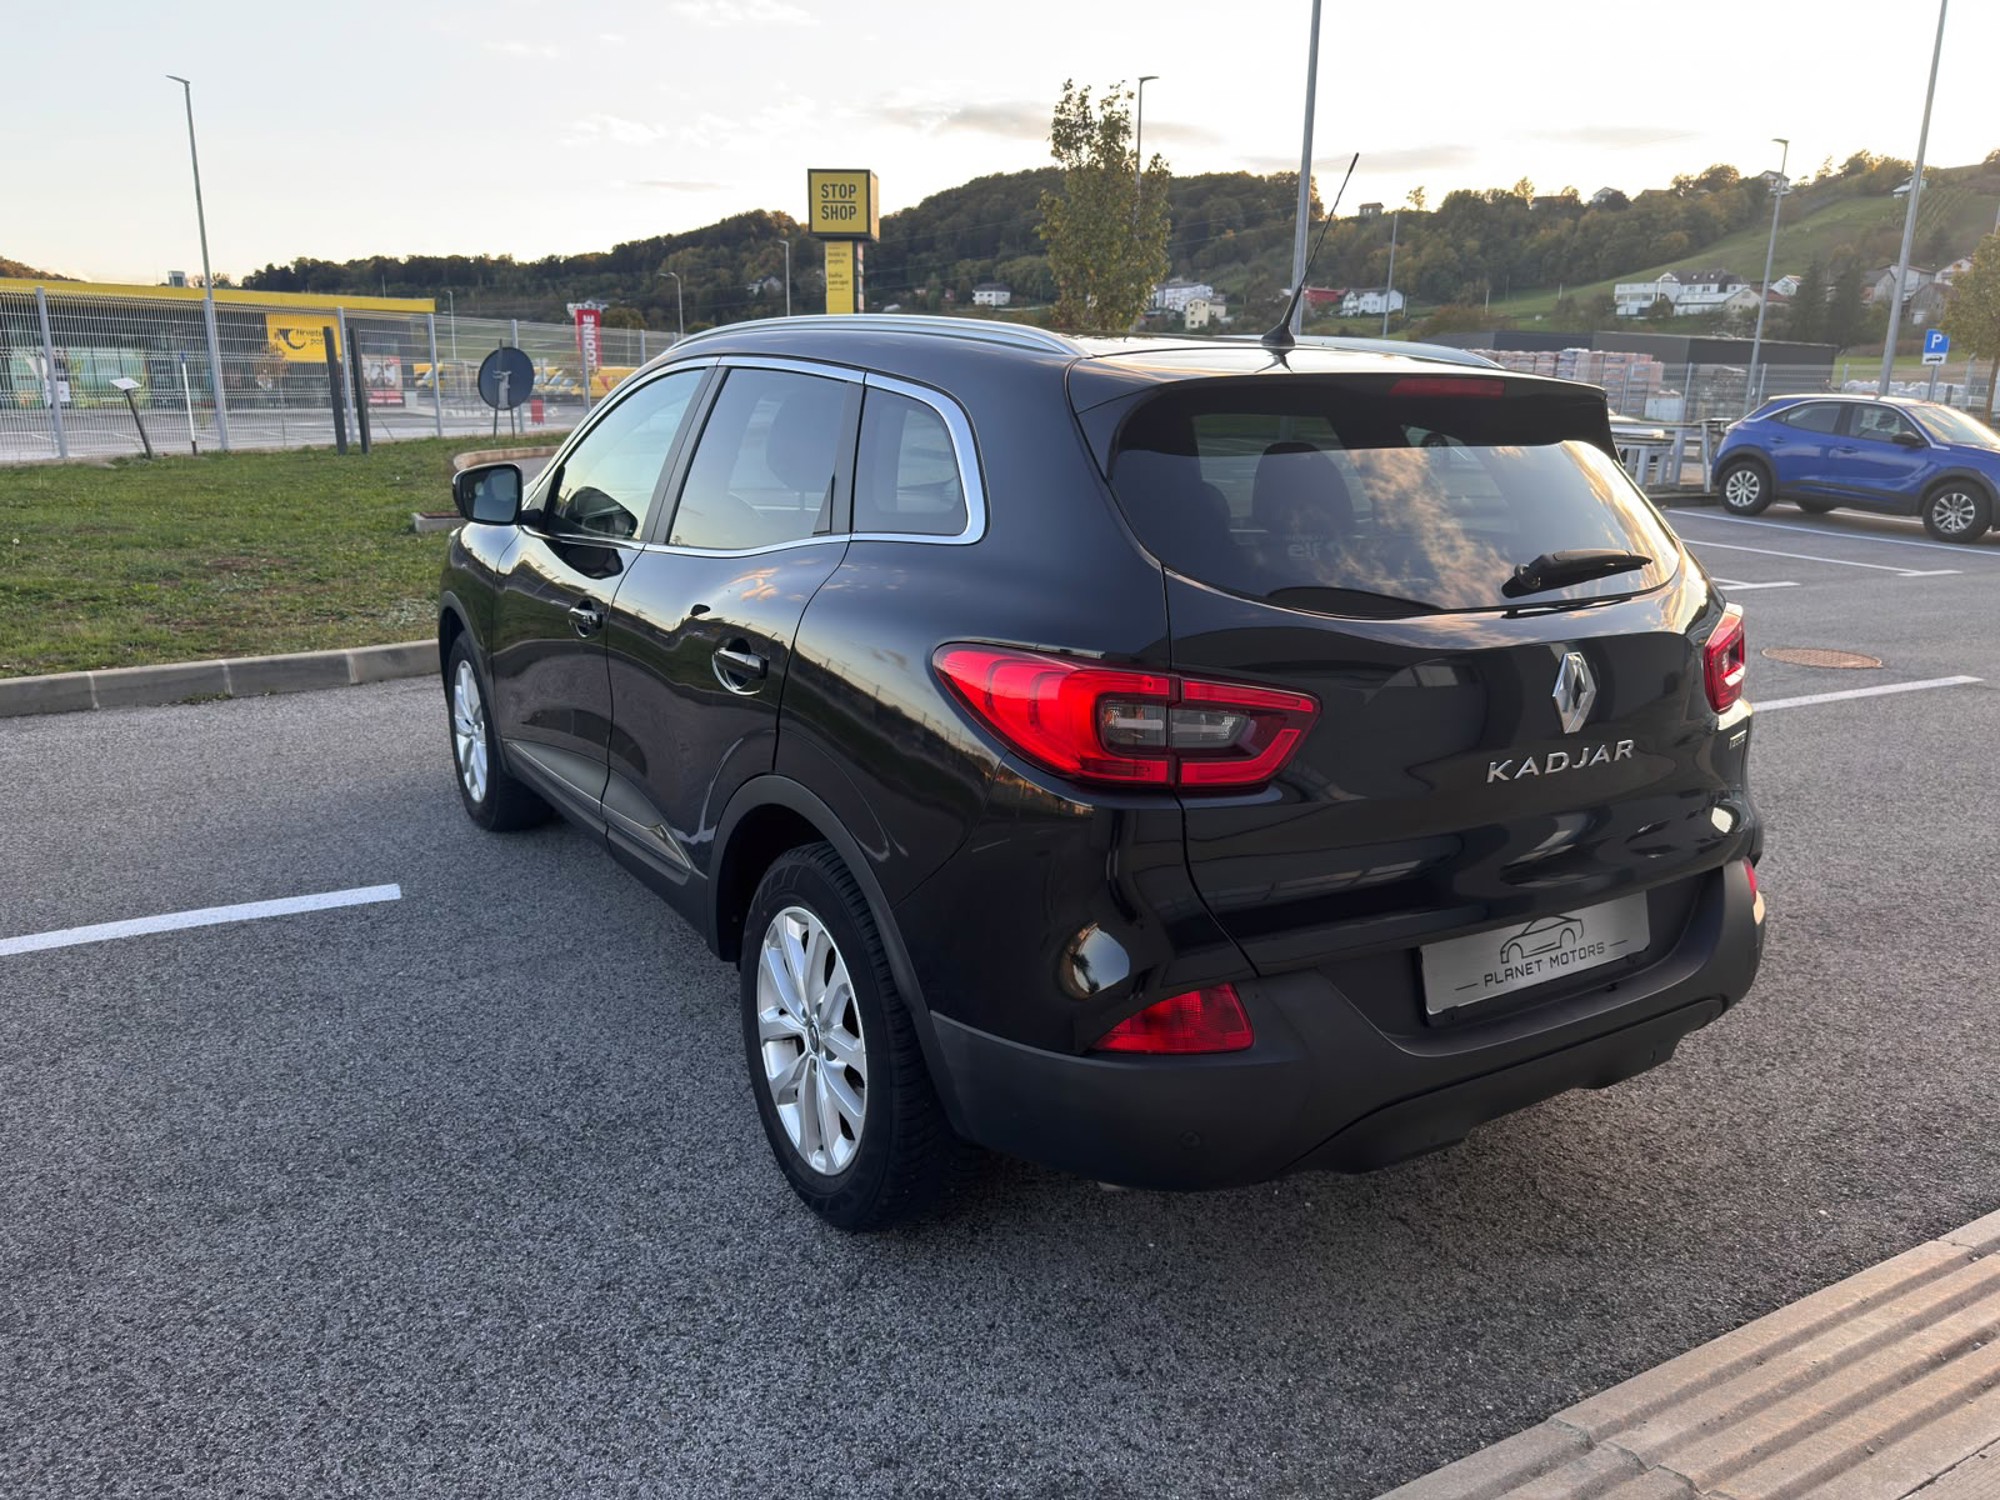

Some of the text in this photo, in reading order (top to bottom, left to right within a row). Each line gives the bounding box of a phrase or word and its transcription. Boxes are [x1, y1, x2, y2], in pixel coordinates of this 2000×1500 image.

[820, 183, 857, 199] STOP
[821, 204, 857, 221] SHOP
[1931, 333, 1943, 349] P
[1486, 739, 1635, 783] KADJAR
[1484, 942, 1606, 987] PLANET MOTORS
